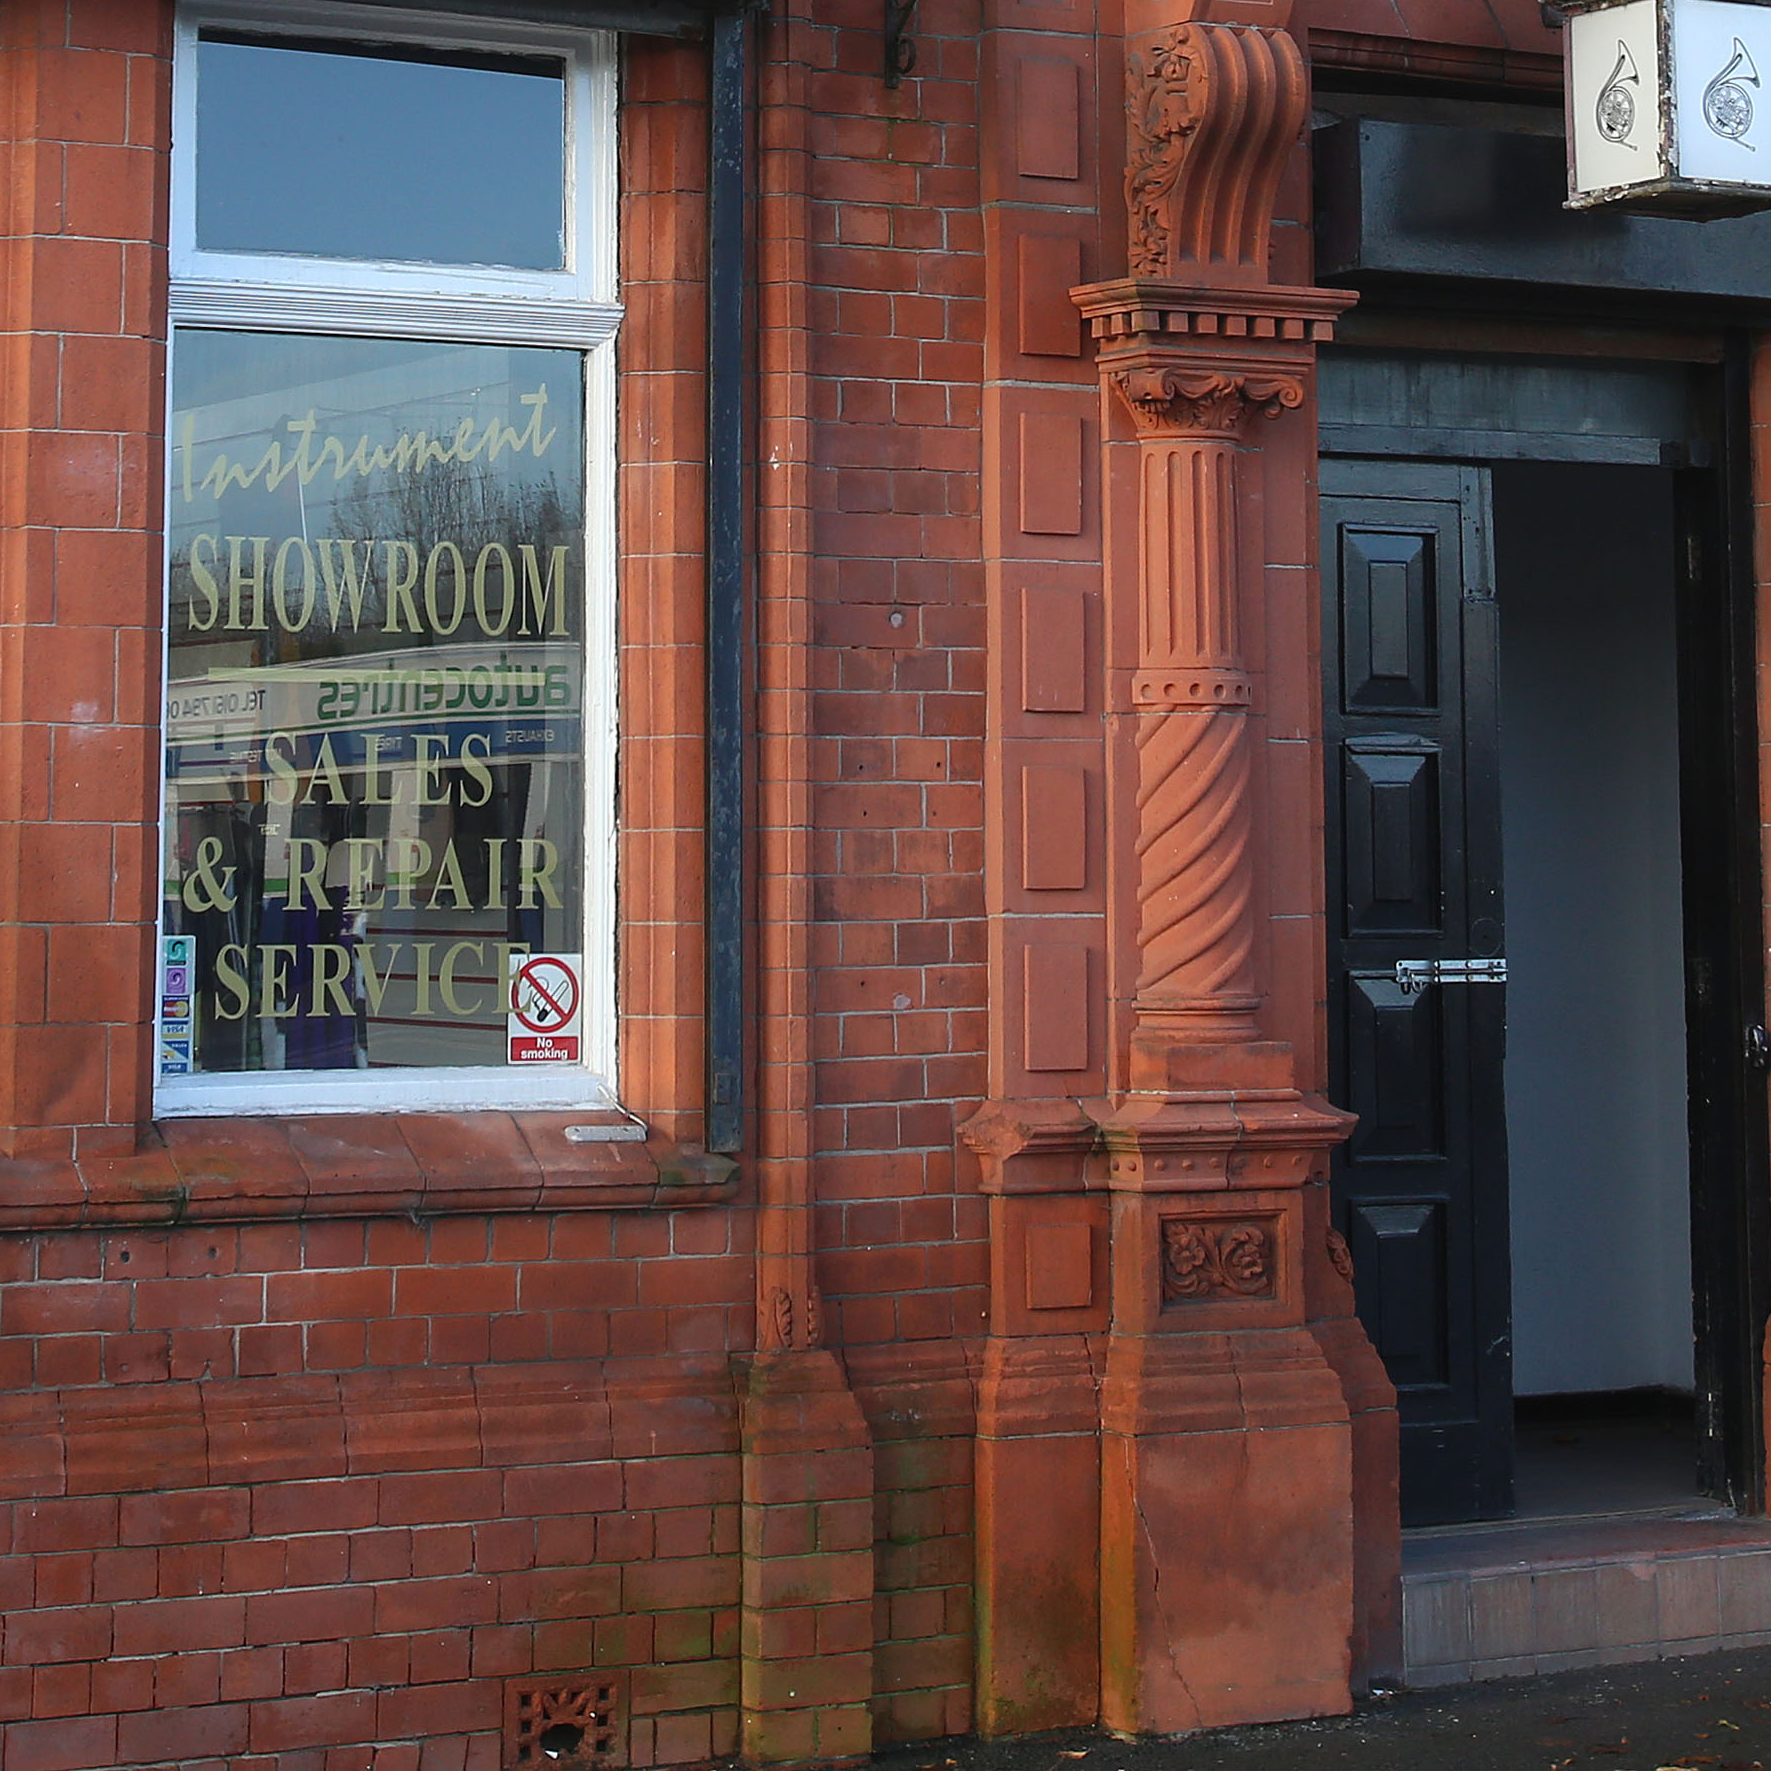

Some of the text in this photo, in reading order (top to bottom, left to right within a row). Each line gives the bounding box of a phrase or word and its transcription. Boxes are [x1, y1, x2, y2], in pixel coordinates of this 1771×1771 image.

[181, 381, 558, 503] Instrument
[188, 533, 571, 637] SHOWROOM
[264, 730, 494, 808] SALES
[182, 836, 564, 914] & REPAIR
[214, 941, 532, 1021] SERVICE
[520, 1048, 569, 1061] smoking
[536, 1037, 554, 1048] No
